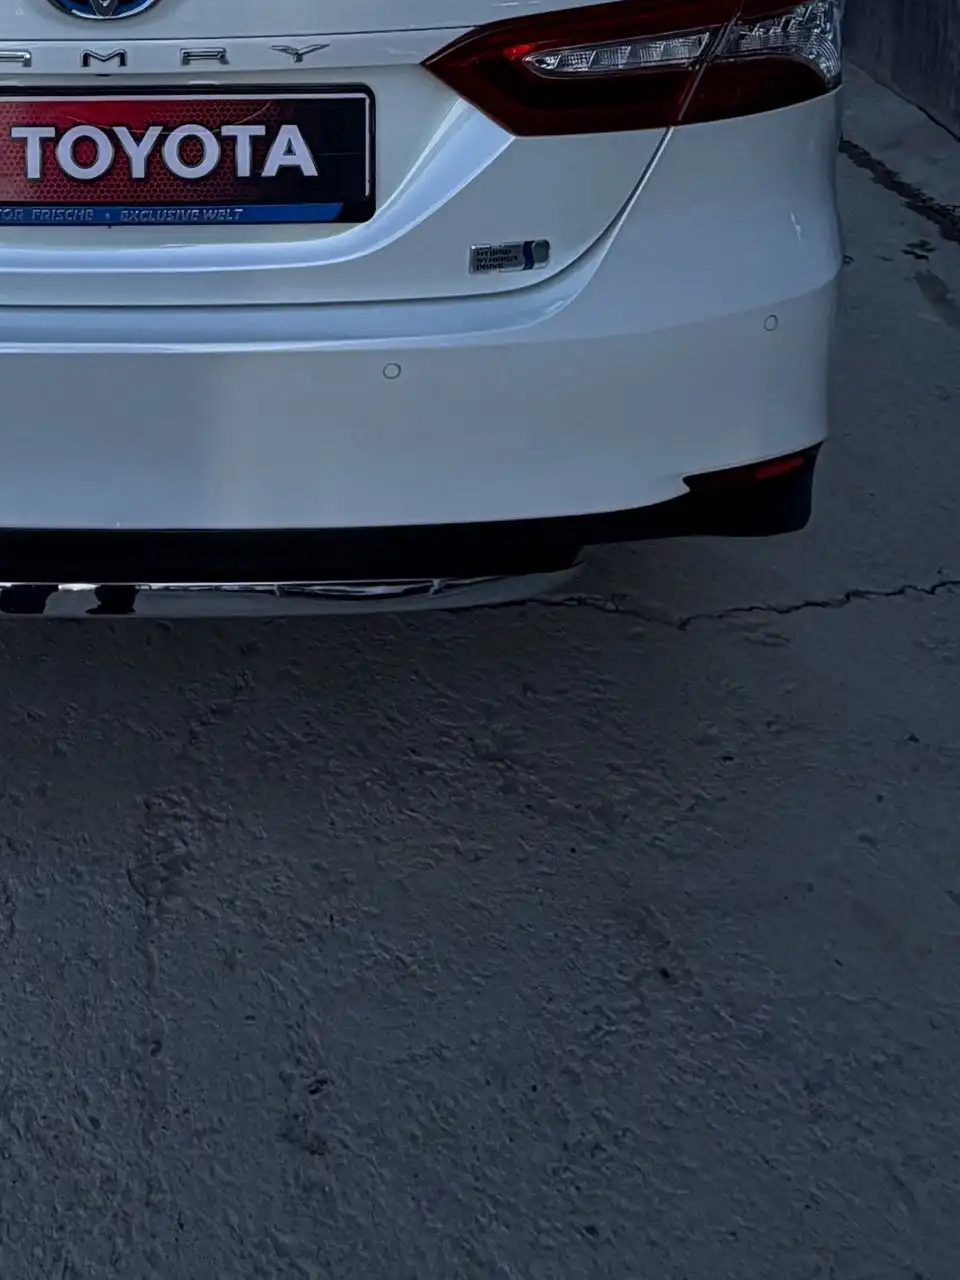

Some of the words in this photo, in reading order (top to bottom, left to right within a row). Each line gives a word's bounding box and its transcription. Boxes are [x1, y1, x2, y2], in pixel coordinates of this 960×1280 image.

[11, 124, 318, 180] TOYOTA
[119, 209, 199, 222] EXCLUSIVE
[202, 208, 243, 221] WELT
